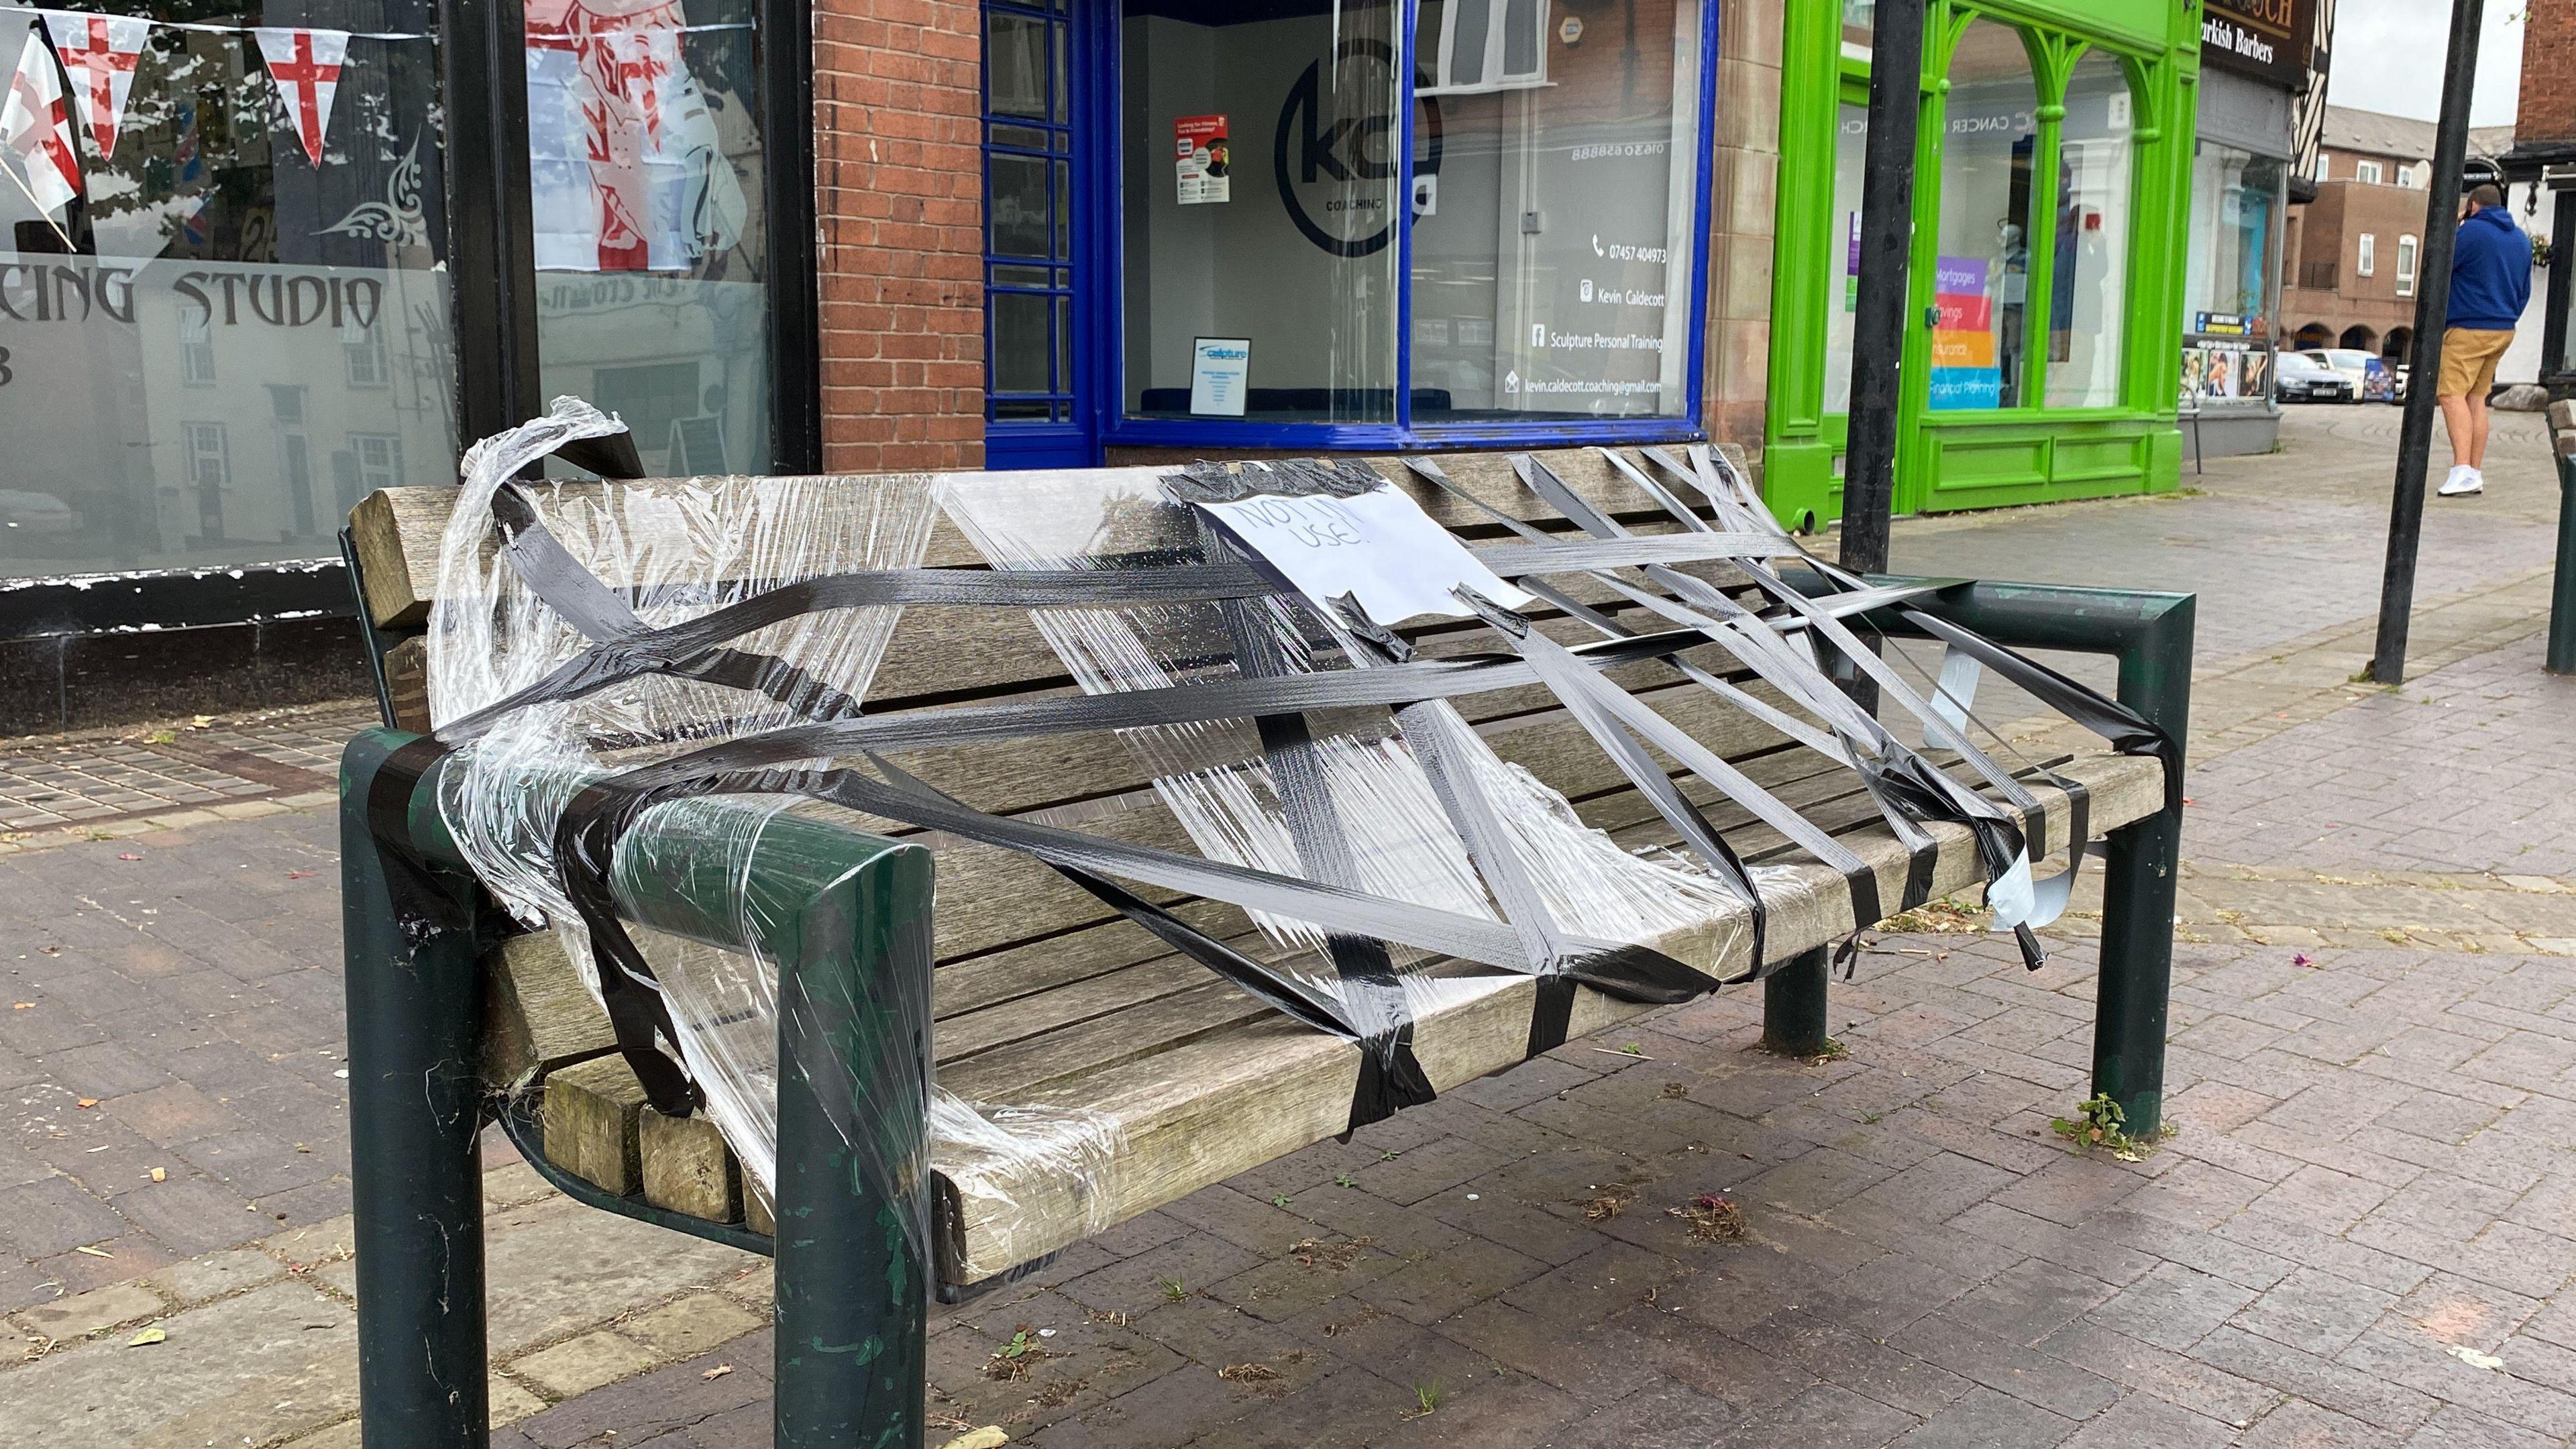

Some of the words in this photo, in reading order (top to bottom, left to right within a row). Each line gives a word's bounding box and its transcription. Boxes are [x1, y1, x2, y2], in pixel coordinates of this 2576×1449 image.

[2201, 18, 2233, 50] urkish
[2235, 27, 2274, 64] Barbers
[1326, 199, 1383, 212] COACHING
[1609, 244, 1635, 261] 07457
[1637, 247, 1667, 264] 404973
[172, 270, 383, 330] STUDIO
[1598, 288, 1622, 304] Kevin
[1625, 289, 1665, 307] Caldecott
[1937, 305, 1963, 323] avings
[1550, 331, 1593, 351] Sculpture
[1594, 333, 1630, 350] Personal
[1631, 333, 1664, 354] Training
[1932, 343, 1968, 356] nsurance
[1524, 378, 1662, 396] kevin.caldecott.coaching@gmail.com
[1963, 380, 1995, 397] Planning
[1228, 499, 1307, 529] NOT
[1305, 498, 1364, 523] IN
